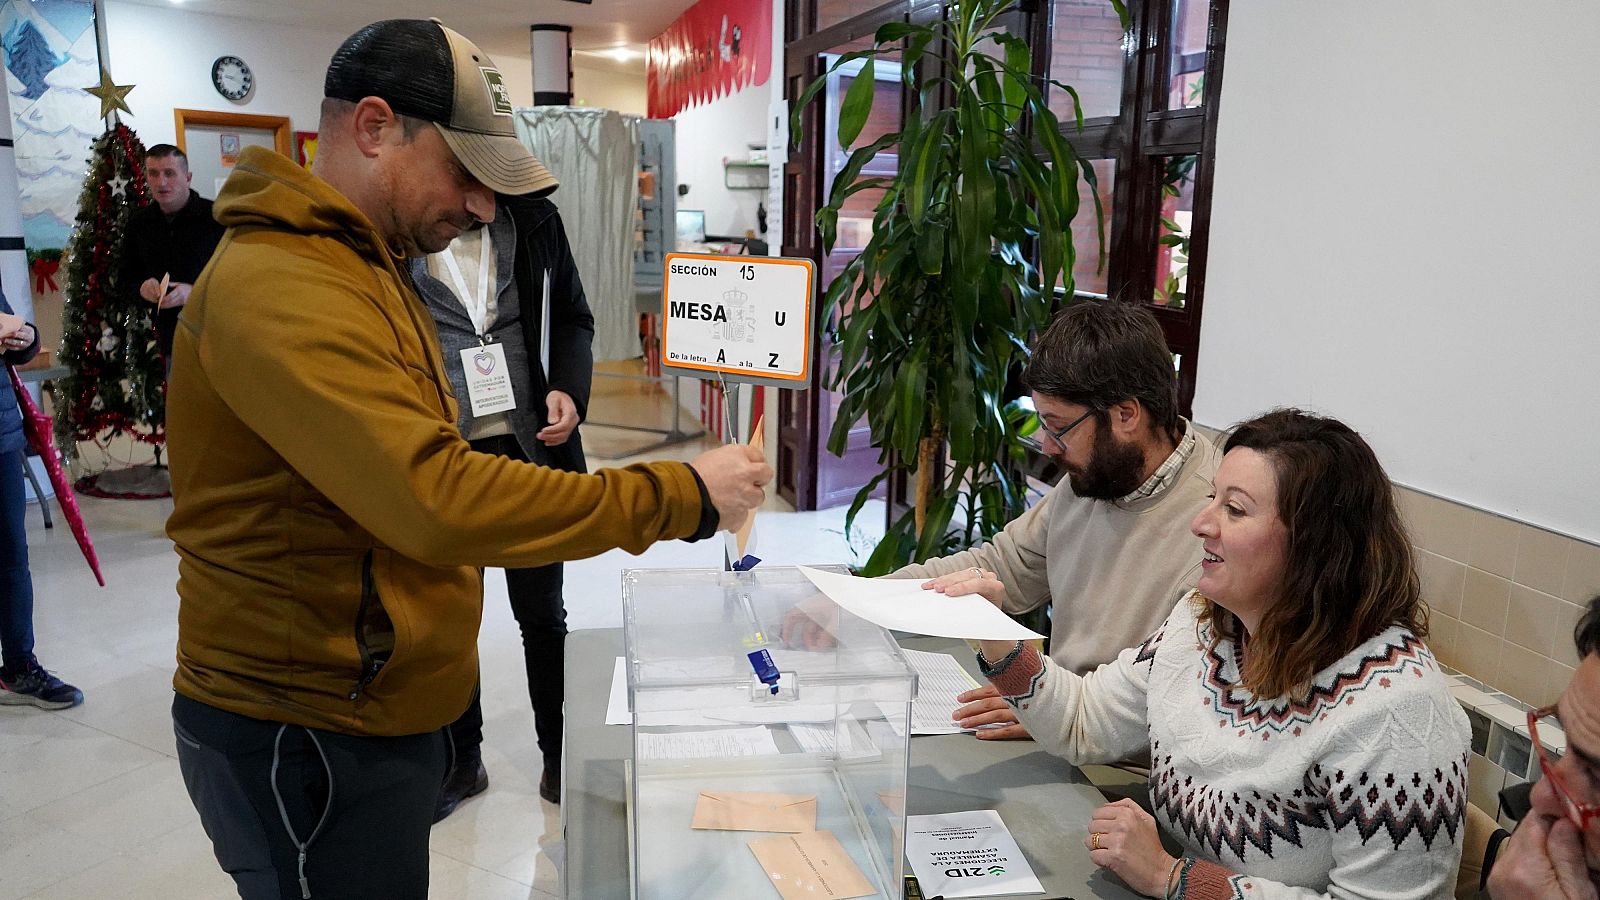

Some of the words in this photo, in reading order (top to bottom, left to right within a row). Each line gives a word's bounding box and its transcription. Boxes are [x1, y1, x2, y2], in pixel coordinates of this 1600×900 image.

[671, 264, 717, 276] SECCIÓN
[740, 264, 755, 280] 15
[670, 301, 728, 322] MESA
[775, 311, 786, 326] U
[716, 348, 726, 363] A
[768, 353, 778, 368] Z
[930, 848, 998, 856] EXTREMADURA
[945, 868, 985, 878] 21D
